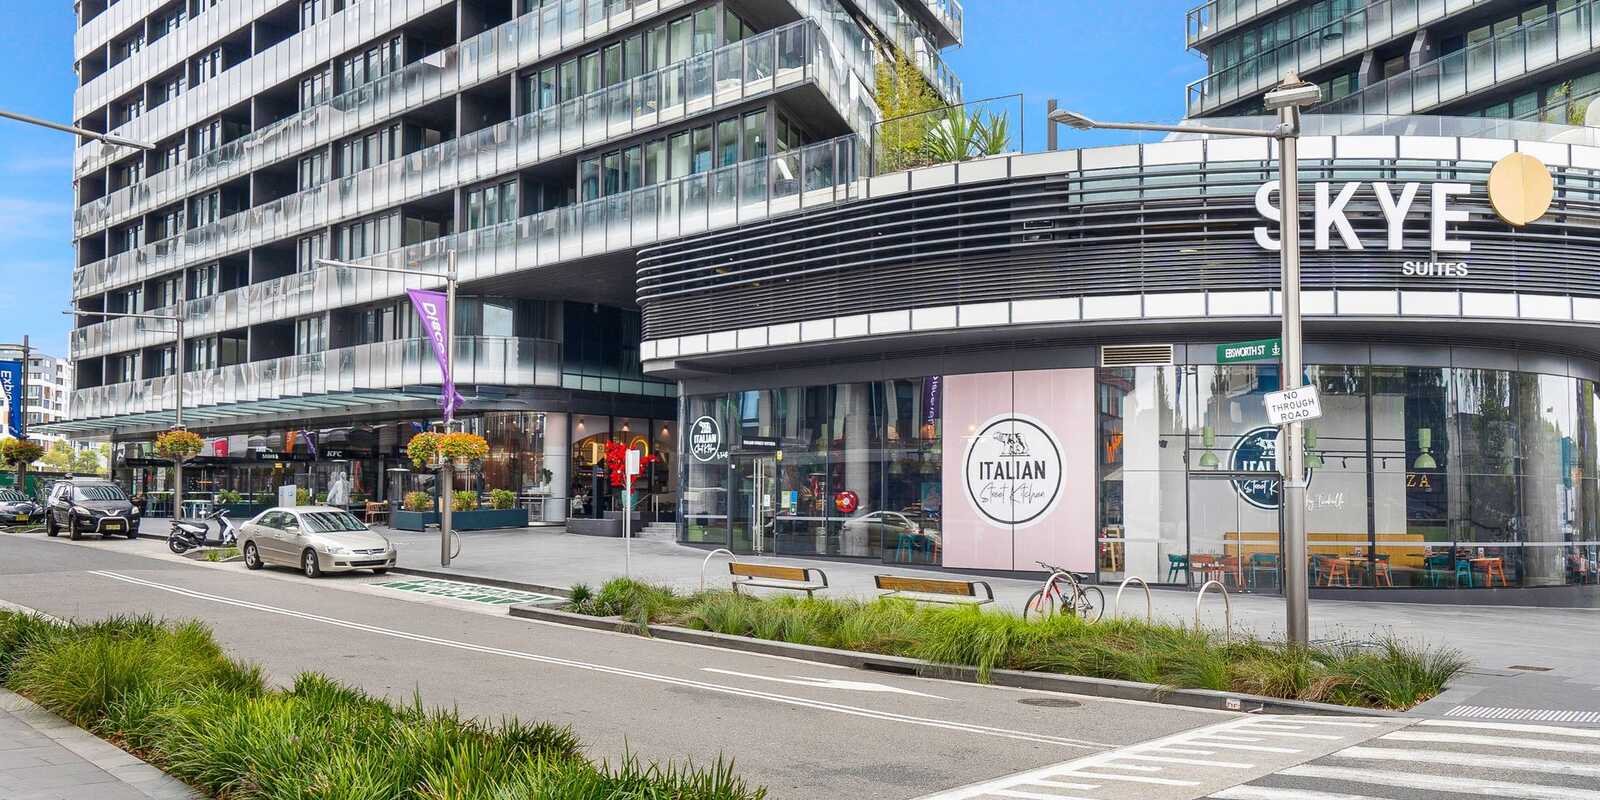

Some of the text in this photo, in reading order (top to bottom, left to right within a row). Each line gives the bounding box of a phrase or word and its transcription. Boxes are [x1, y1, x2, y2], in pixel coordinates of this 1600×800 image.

[1253, 179, 1472, 252] SKYE
[1402, 260, 1469, 278] SUITES
[1225, 344, 1266, 358] EBSWORTH ST
[1283, 391, 1298, 400] NO
[1272, 398, 1315, 412] THROUGH
[1280, 409, 1309, 421] ROAD
[693, 434, 717, 444] ITALIAN
[979, 460, 1046, 480] ITALIAN
[979, 482, 1046, 504] Street Kitchen
